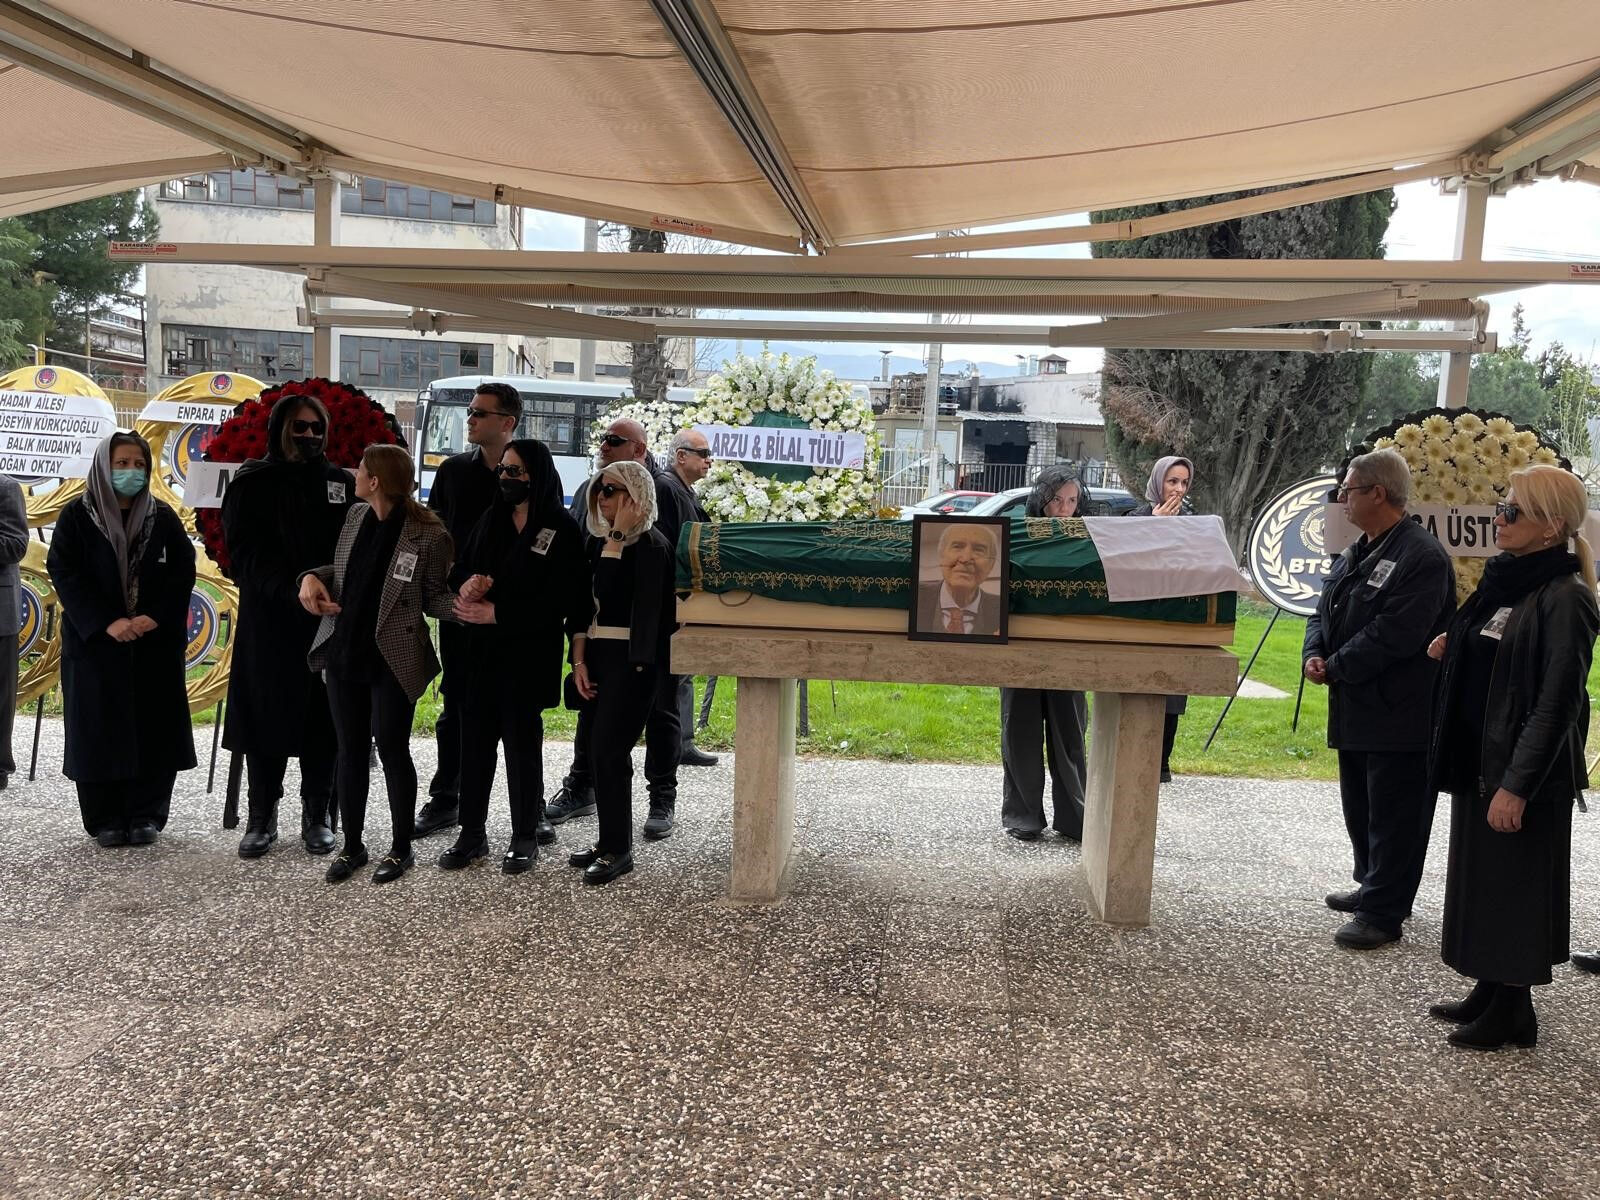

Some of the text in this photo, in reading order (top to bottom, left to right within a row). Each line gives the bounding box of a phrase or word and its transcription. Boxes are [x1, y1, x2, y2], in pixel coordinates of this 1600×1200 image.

[35, 393, 67, 411] AİLESİ
[177, 406, 214, 421] ENPARA
[34, 414, 99, 435] KÜRKÇÜOĞLU
[7, 436, 81, 455] BALIK MUDANYA
[711, 430, 845, 466] ARZU & BİLAL TÜLÜ
[31, 459, 63, 474] OKTAY
